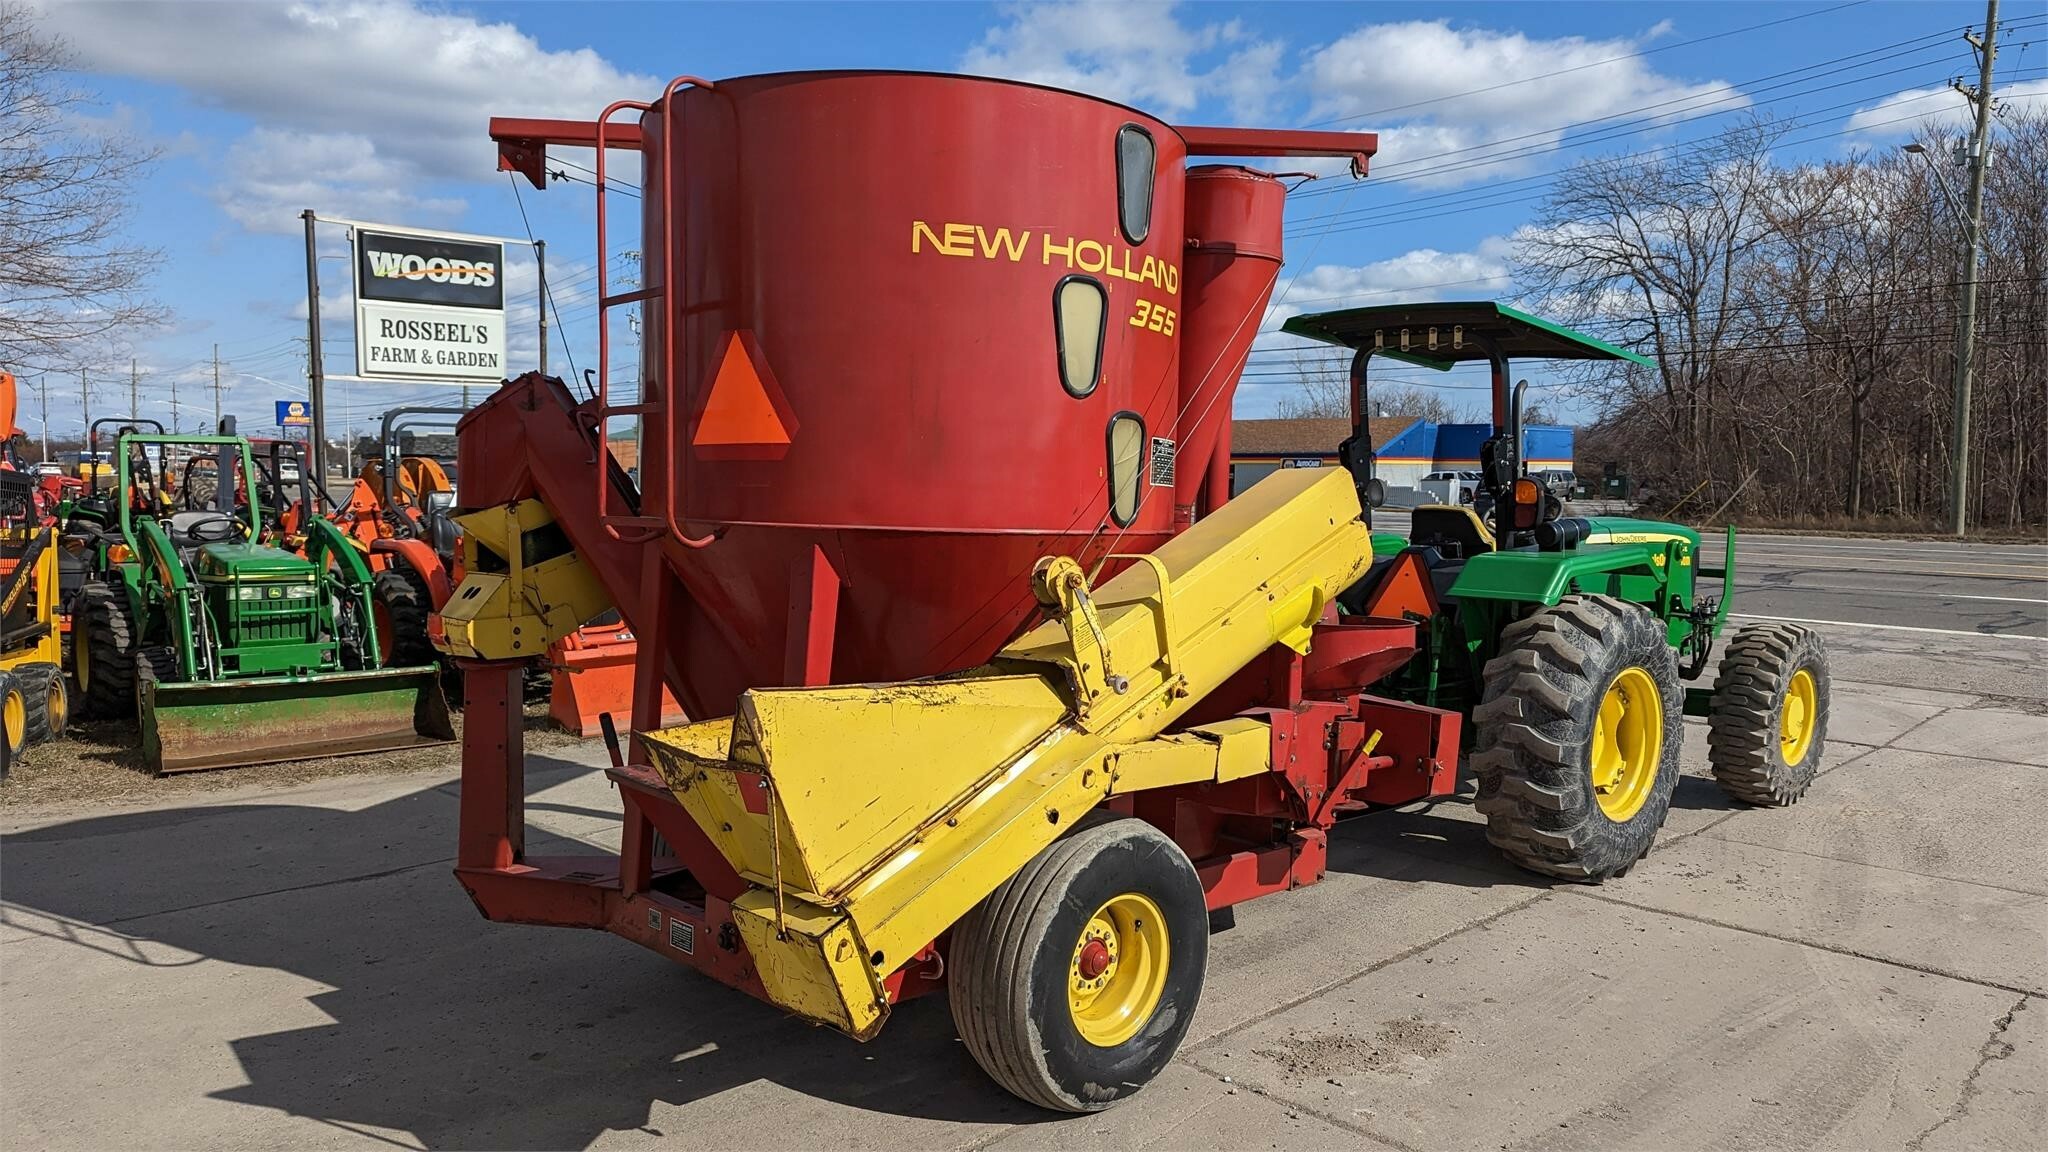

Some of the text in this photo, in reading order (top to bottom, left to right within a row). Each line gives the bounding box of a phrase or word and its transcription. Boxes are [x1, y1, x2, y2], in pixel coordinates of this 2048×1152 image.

[367, 250, 495, 287] WOODS
[912, 221, 1179, 295] NEW HOLLAND
[380, 318, 488, 344] ROSSEEL'S
[1129, 299, 1176, 337] 355
[371, 346, 498, 368] FARM & GARDEN
